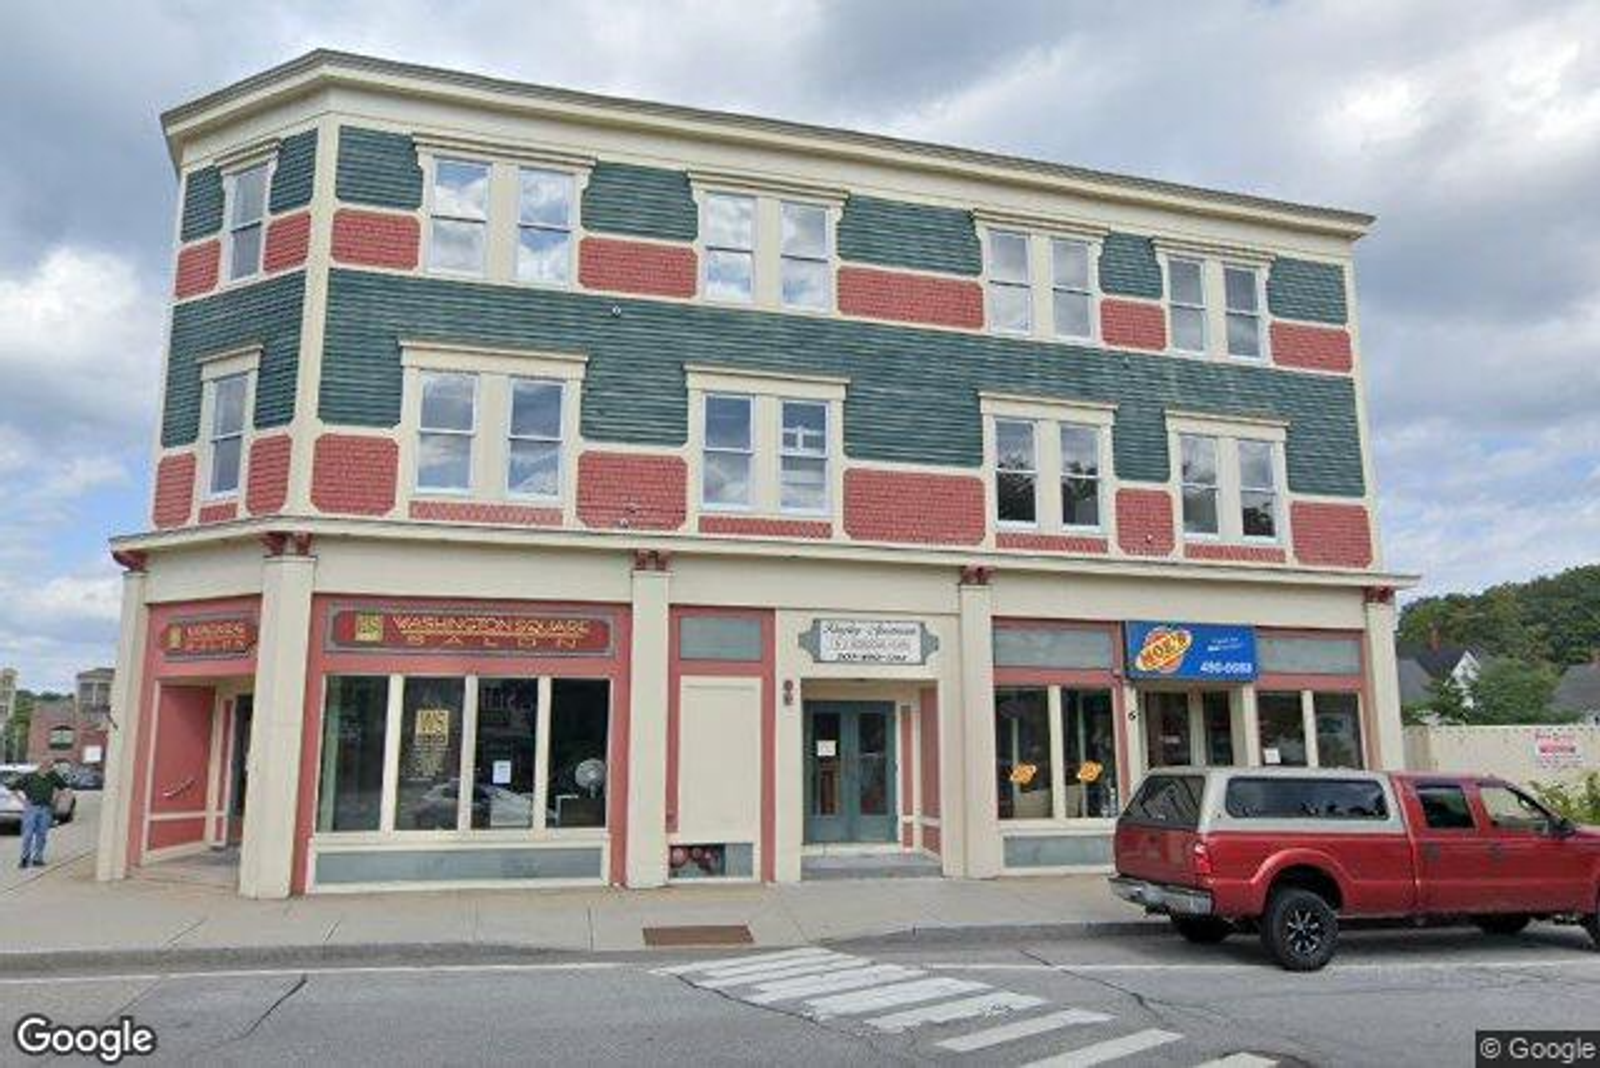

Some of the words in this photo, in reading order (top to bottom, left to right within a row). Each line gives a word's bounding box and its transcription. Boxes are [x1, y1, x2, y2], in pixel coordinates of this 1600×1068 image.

[393, 616, 511, 631] WASHINGTON
[515, 619, 591, 634] SQUARE
[407, 635, 577, 648] SALON
